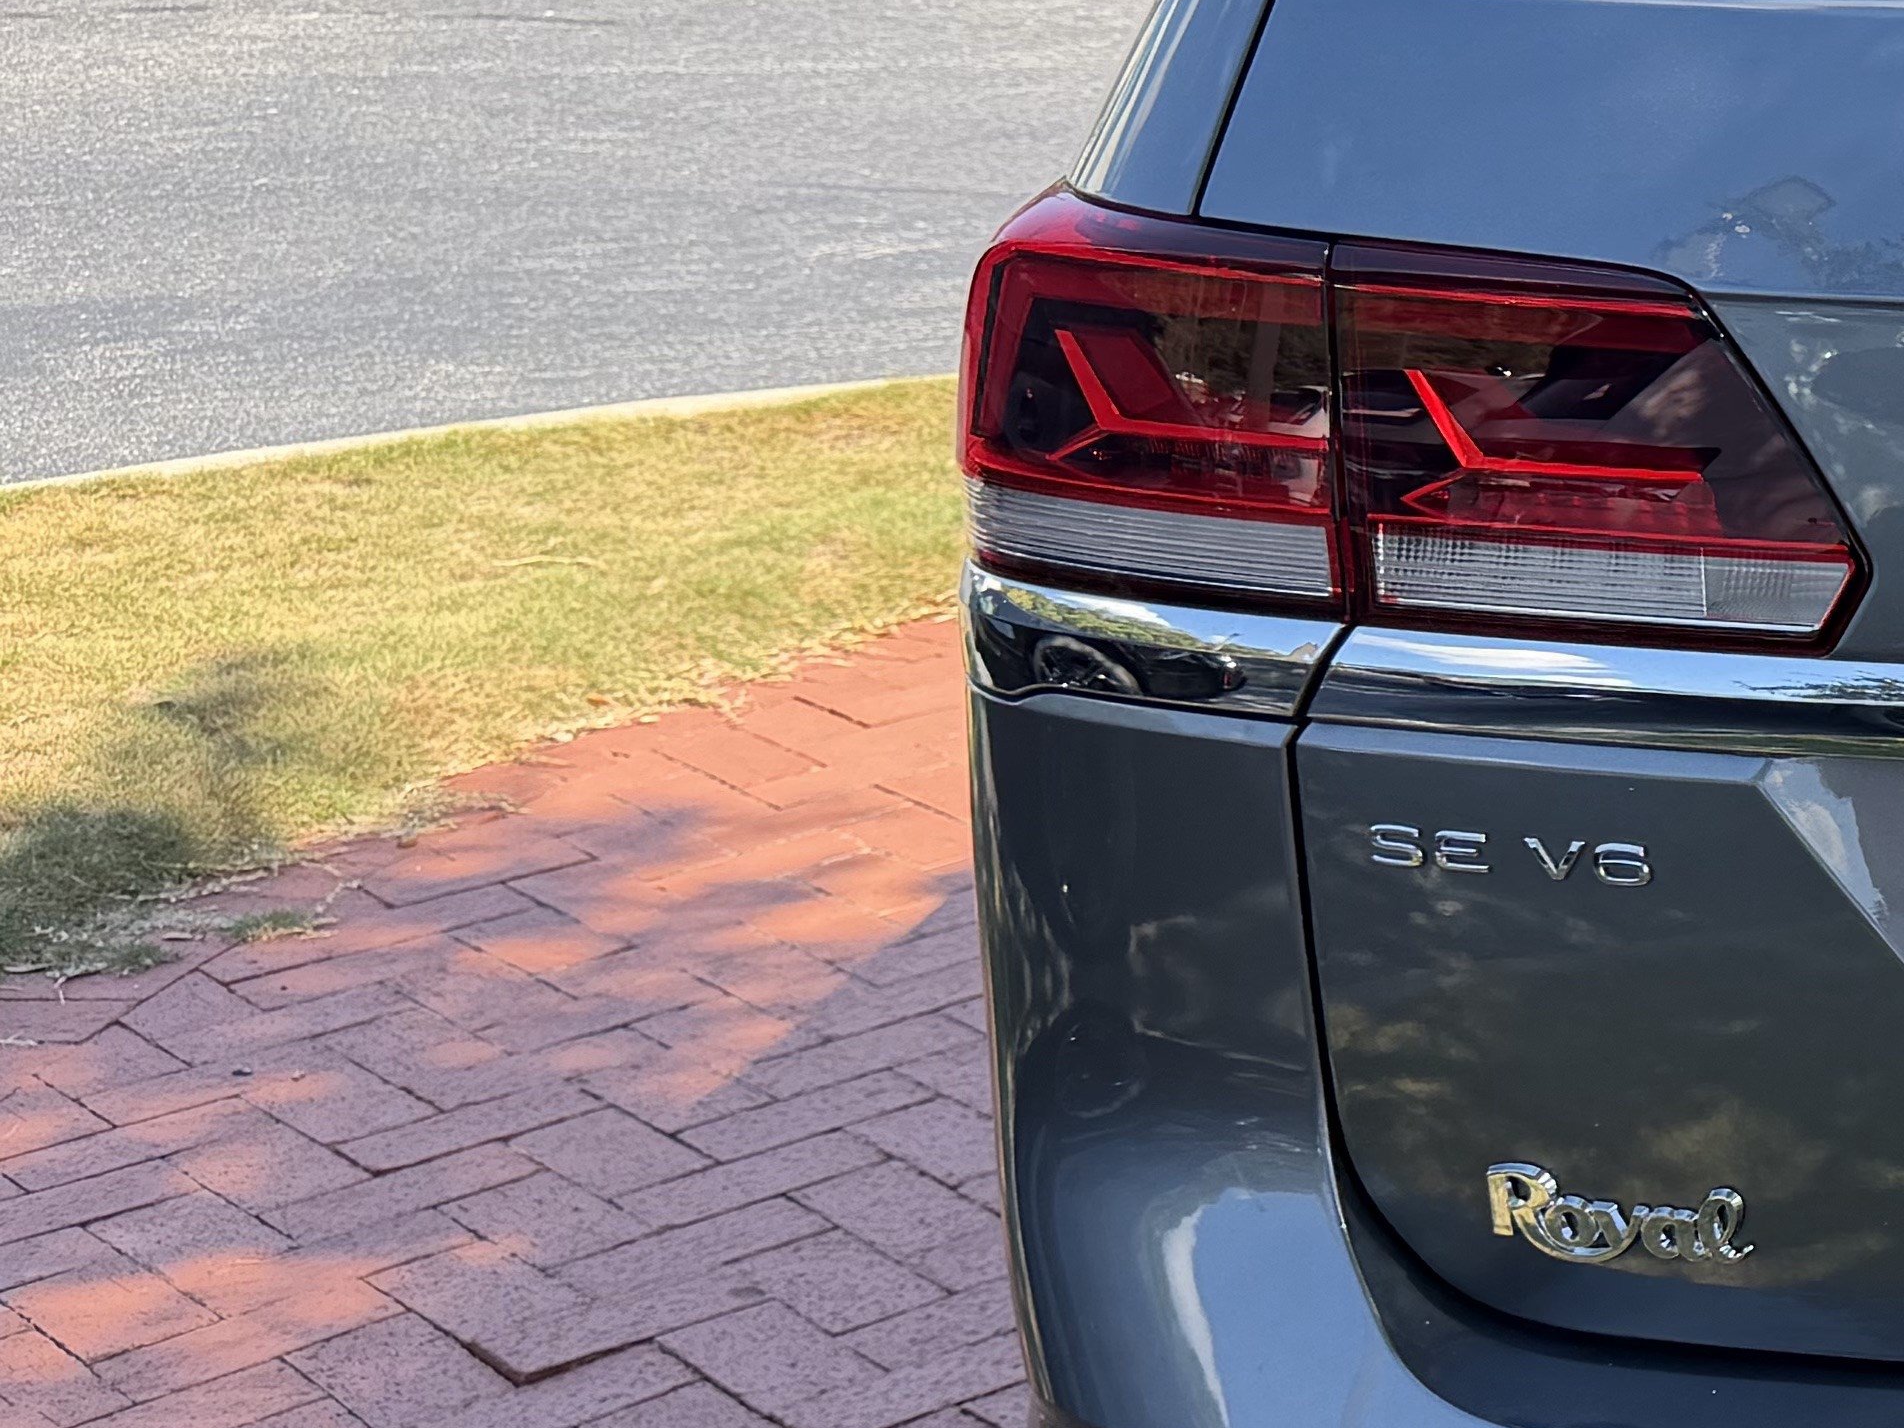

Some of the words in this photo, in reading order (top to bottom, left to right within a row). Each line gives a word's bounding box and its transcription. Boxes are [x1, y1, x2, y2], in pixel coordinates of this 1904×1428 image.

[1370, 824, 1489, 873] SE
[1524, 836, 1653, 886] V6
[1487, 1162, 1754, 1263] Royal
